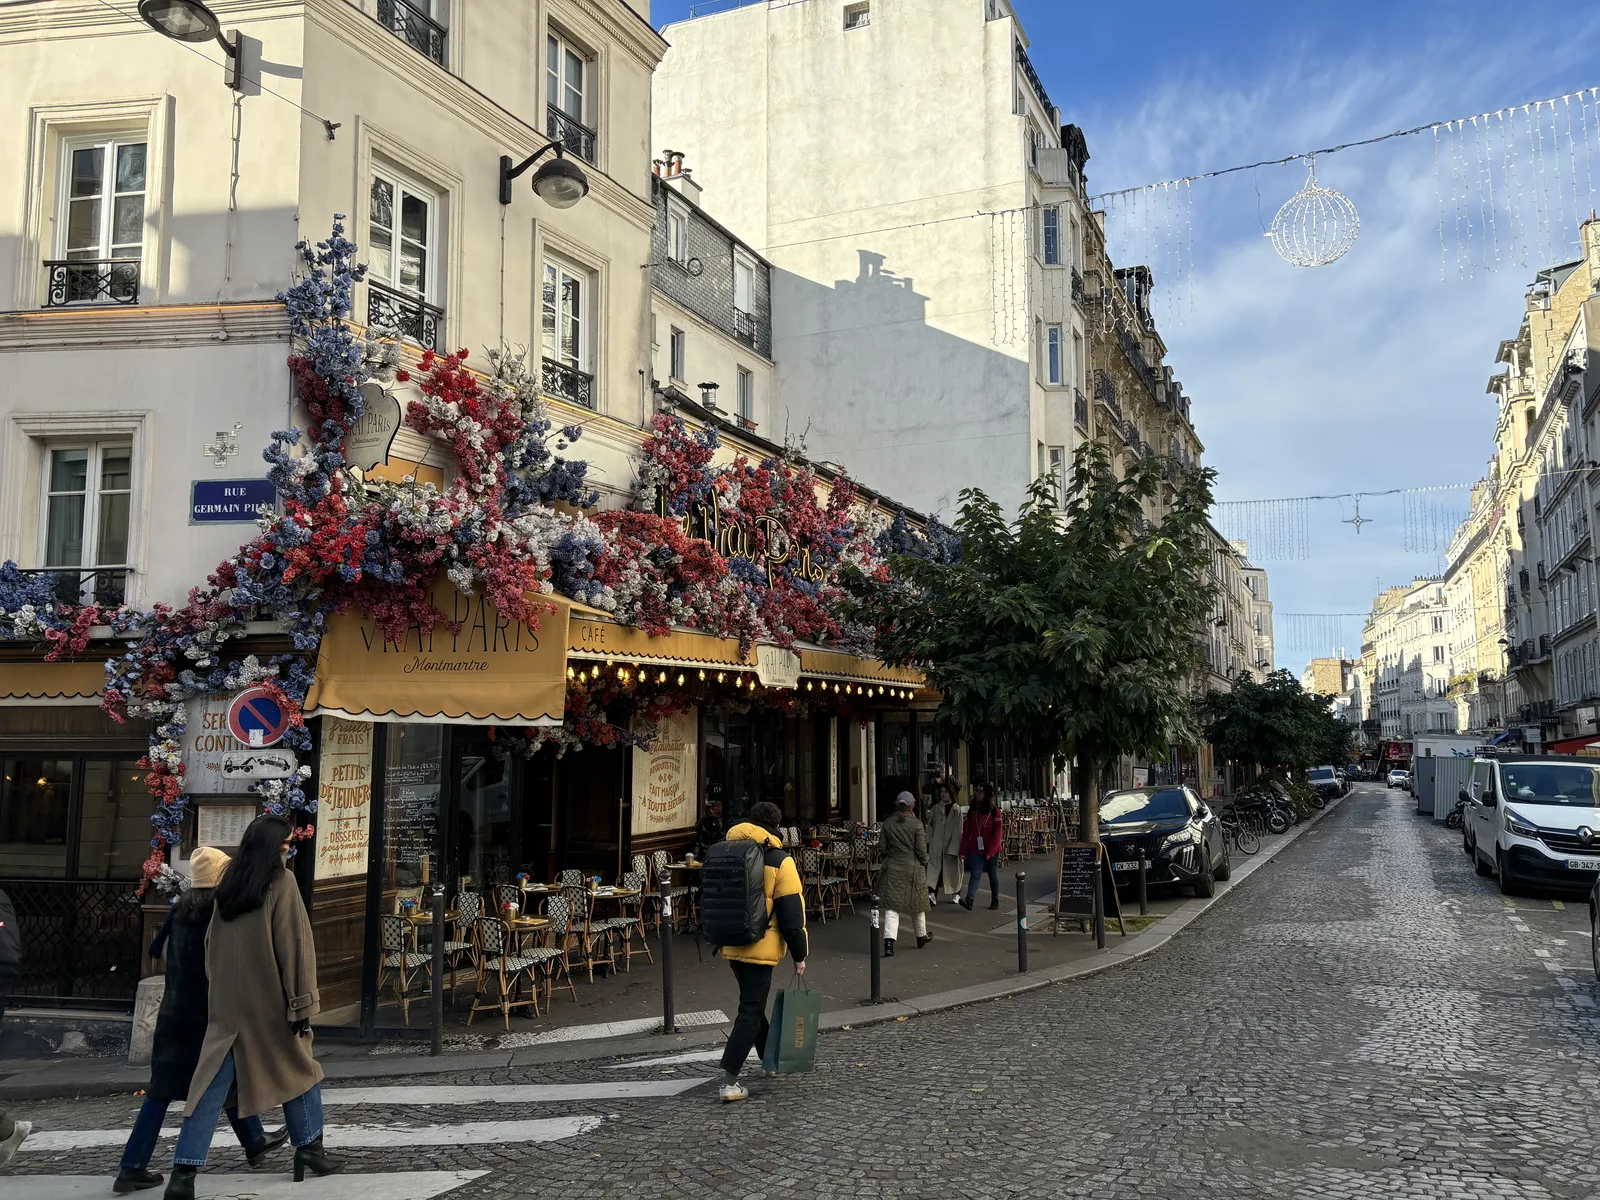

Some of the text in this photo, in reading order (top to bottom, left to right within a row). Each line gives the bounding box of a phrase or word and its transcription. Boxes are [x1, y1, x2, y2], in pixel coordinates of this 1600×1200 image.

[367, 412, 391, 434] PARIS
[224, 487, 247, 497] RUE
[194, 503, 275, 513] GERMAIN PILN
[452, 590, 540, 653] PARIS
[581, 626, 605, 644] CAFÉ
[403, 656, 489, 674] Montmartre
[202, 712, 228, 730] SER
[337, 733, 364, 745] FRAIS
[331, 764, 366, 782] PETITS
[320, 783, 371, 811] DÉJEUNER
[649, 781, 680, 799] FAIT MAISON
[647, 798, 667, 812] TOUTE
[329, 829, 364, 844] DESSERTS
